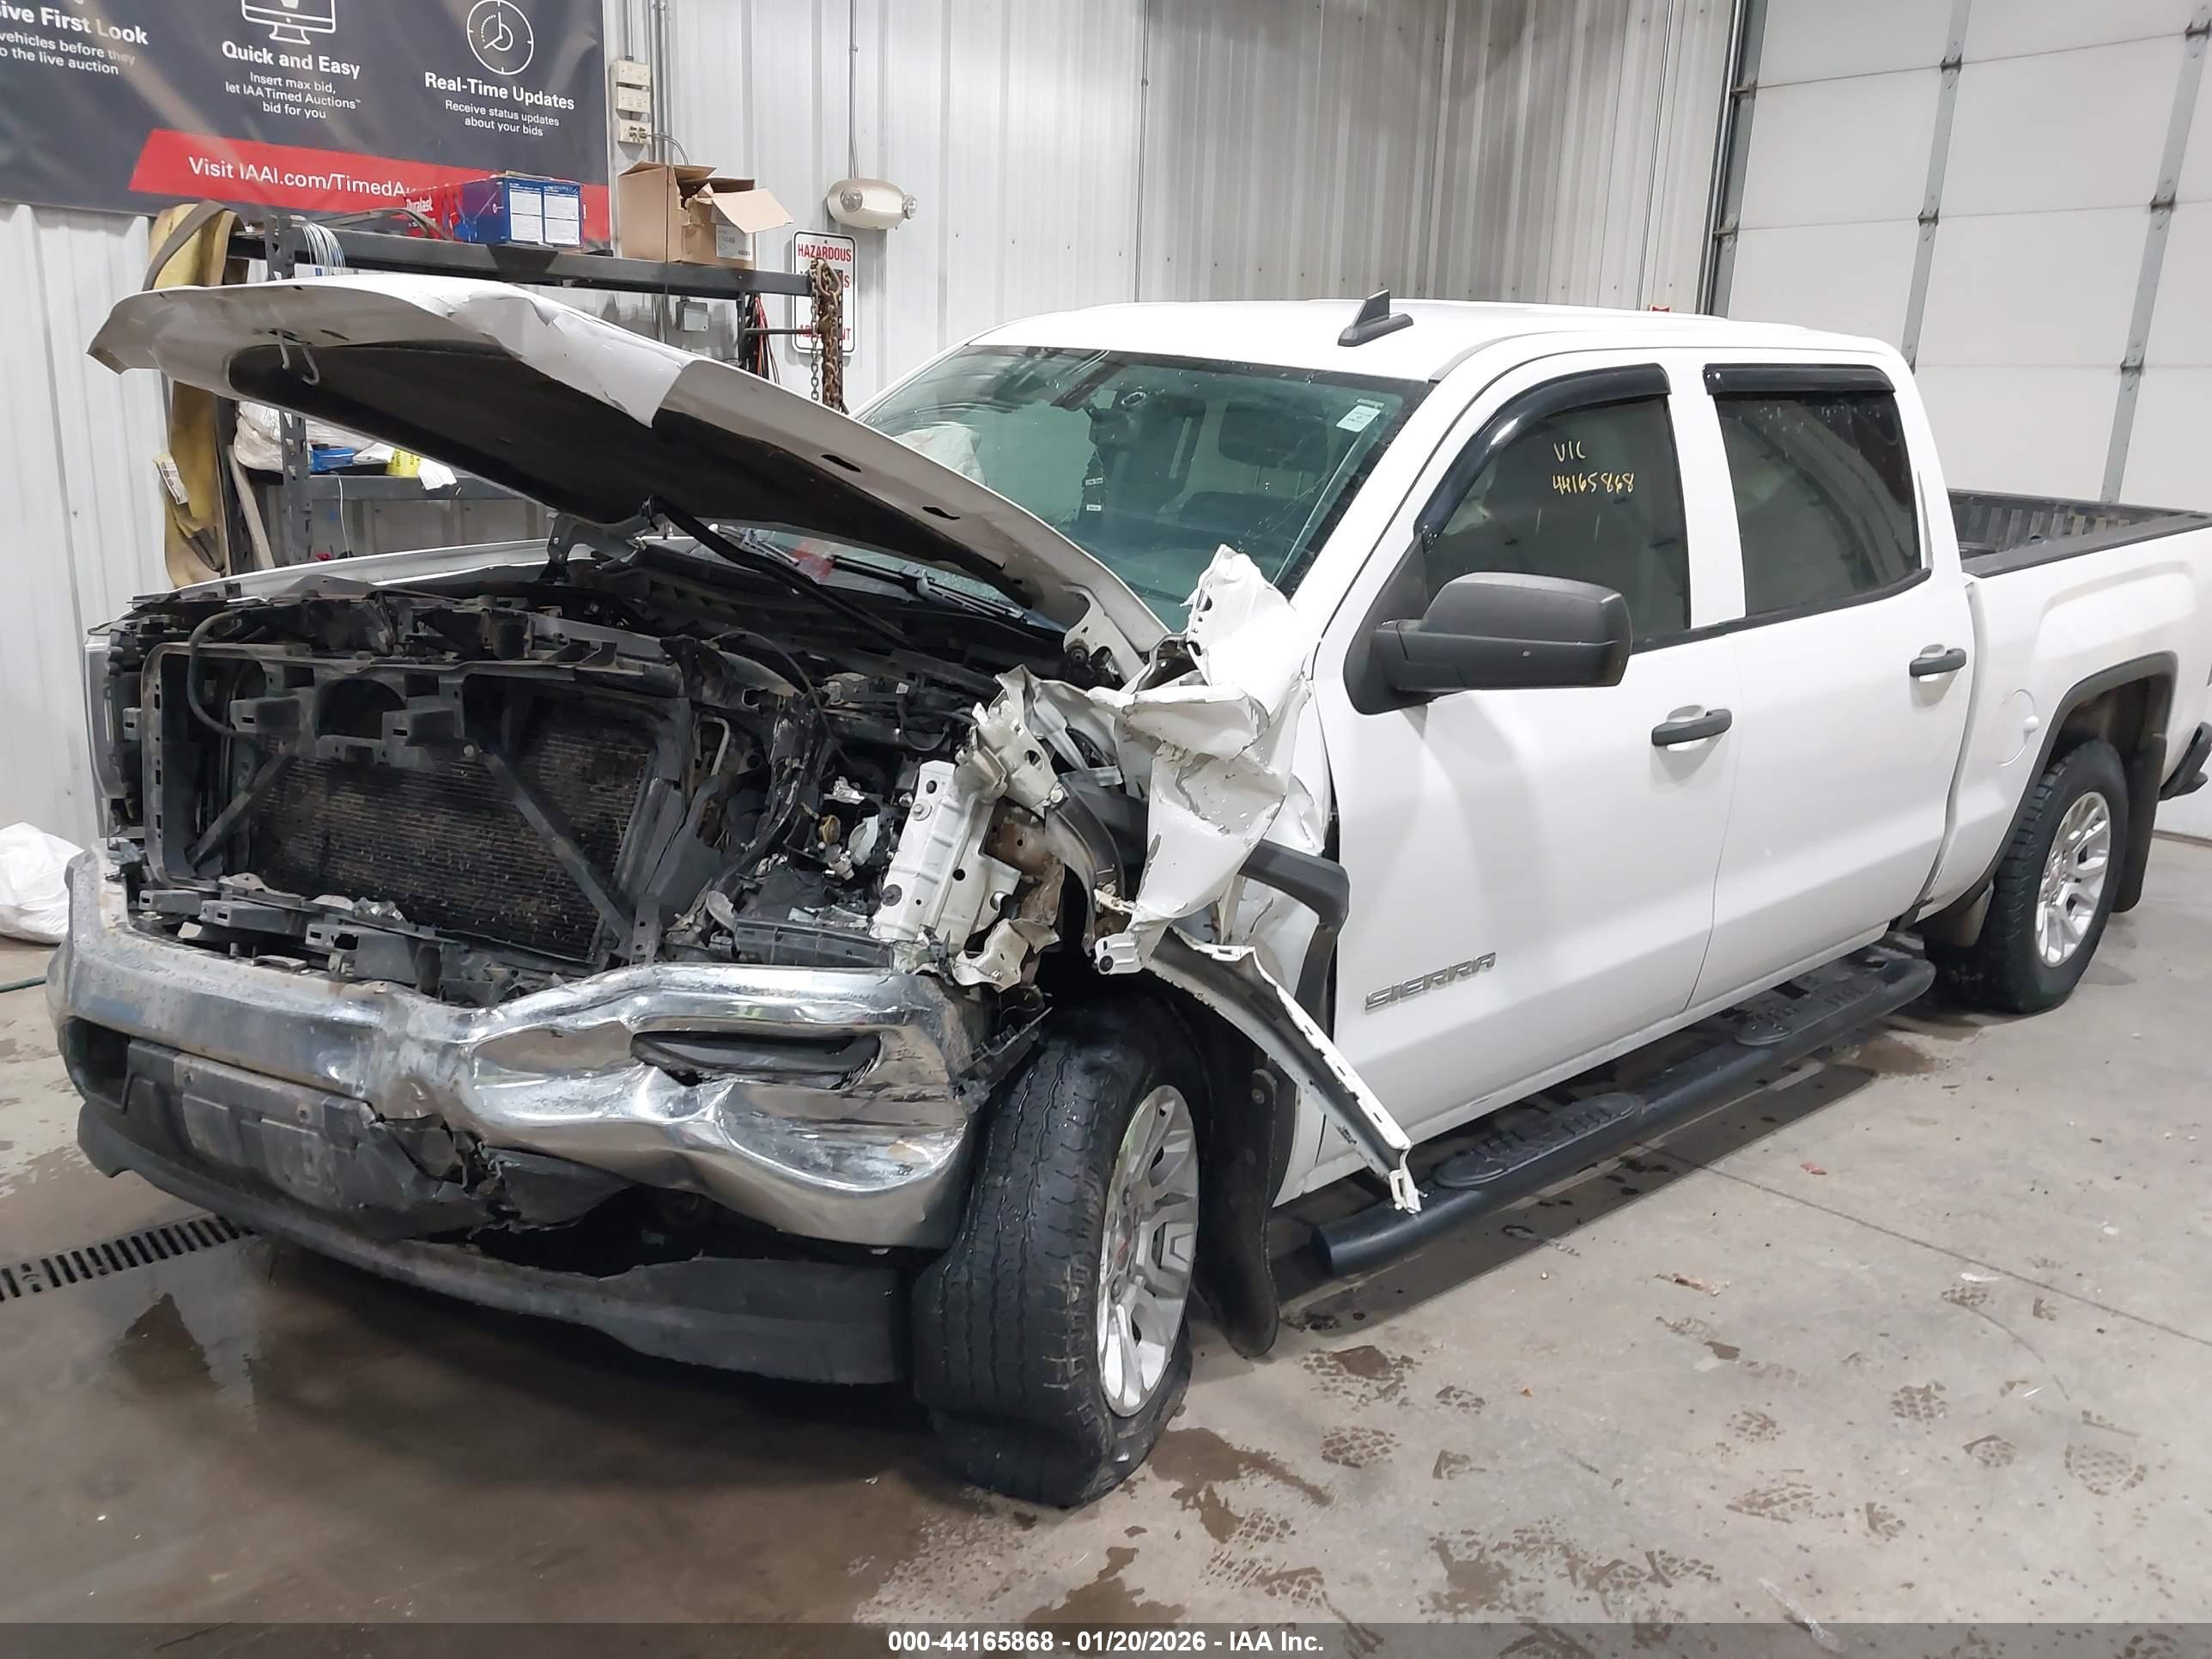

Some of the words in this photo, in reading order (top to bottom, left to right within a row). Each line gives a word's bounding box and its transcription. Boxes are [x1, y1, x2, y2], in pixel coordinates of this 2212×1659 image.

[0, 0, 34, 23] ive
[40, 7, 92, 33] First
[96, 19, 149, 45] Look
[0, 31, 56, 50] vehicles
[60, 40, 105, 58] before
[108, 49, 136, 67] they
[12, 47, 35, 62] the
[40, 52, 64, 66] live
[69, 58, 118, 76] auction
[222, 40, 274, 65] Quick
[279, 53, 313, 70] and
[319, 56, 361, 79] Easy
[225, 82, 240, 94] let
[305, 94, 361, 109] Auctions
[250, 71, 282, 87] Insert
[285, 78, 311, 90] max
[314, 80, 337, 94] bid,
[424, 71, 508, 99] Real-Time
[513, 86, 574, 110] Updates
[262, 101, 281, 113] bid
[284, 104, 301, 116] for
[304, 109, 326, 118] you
[445, 100, 486, 115] Receive
[489, 108, 519, 120] status
[521, 112, 559, 126] updates
[465, 117, 495, 129] about
[497, 122, 520, 132] your
[522, 124, 544, 137] bids
[188, 156, 234, 179] Visit
[798, 243, 852, 263] HAZARDOUS
[1553, 471, 1634, 495] 44165868
[1365, 952, 1496, 1011] SIERRA
